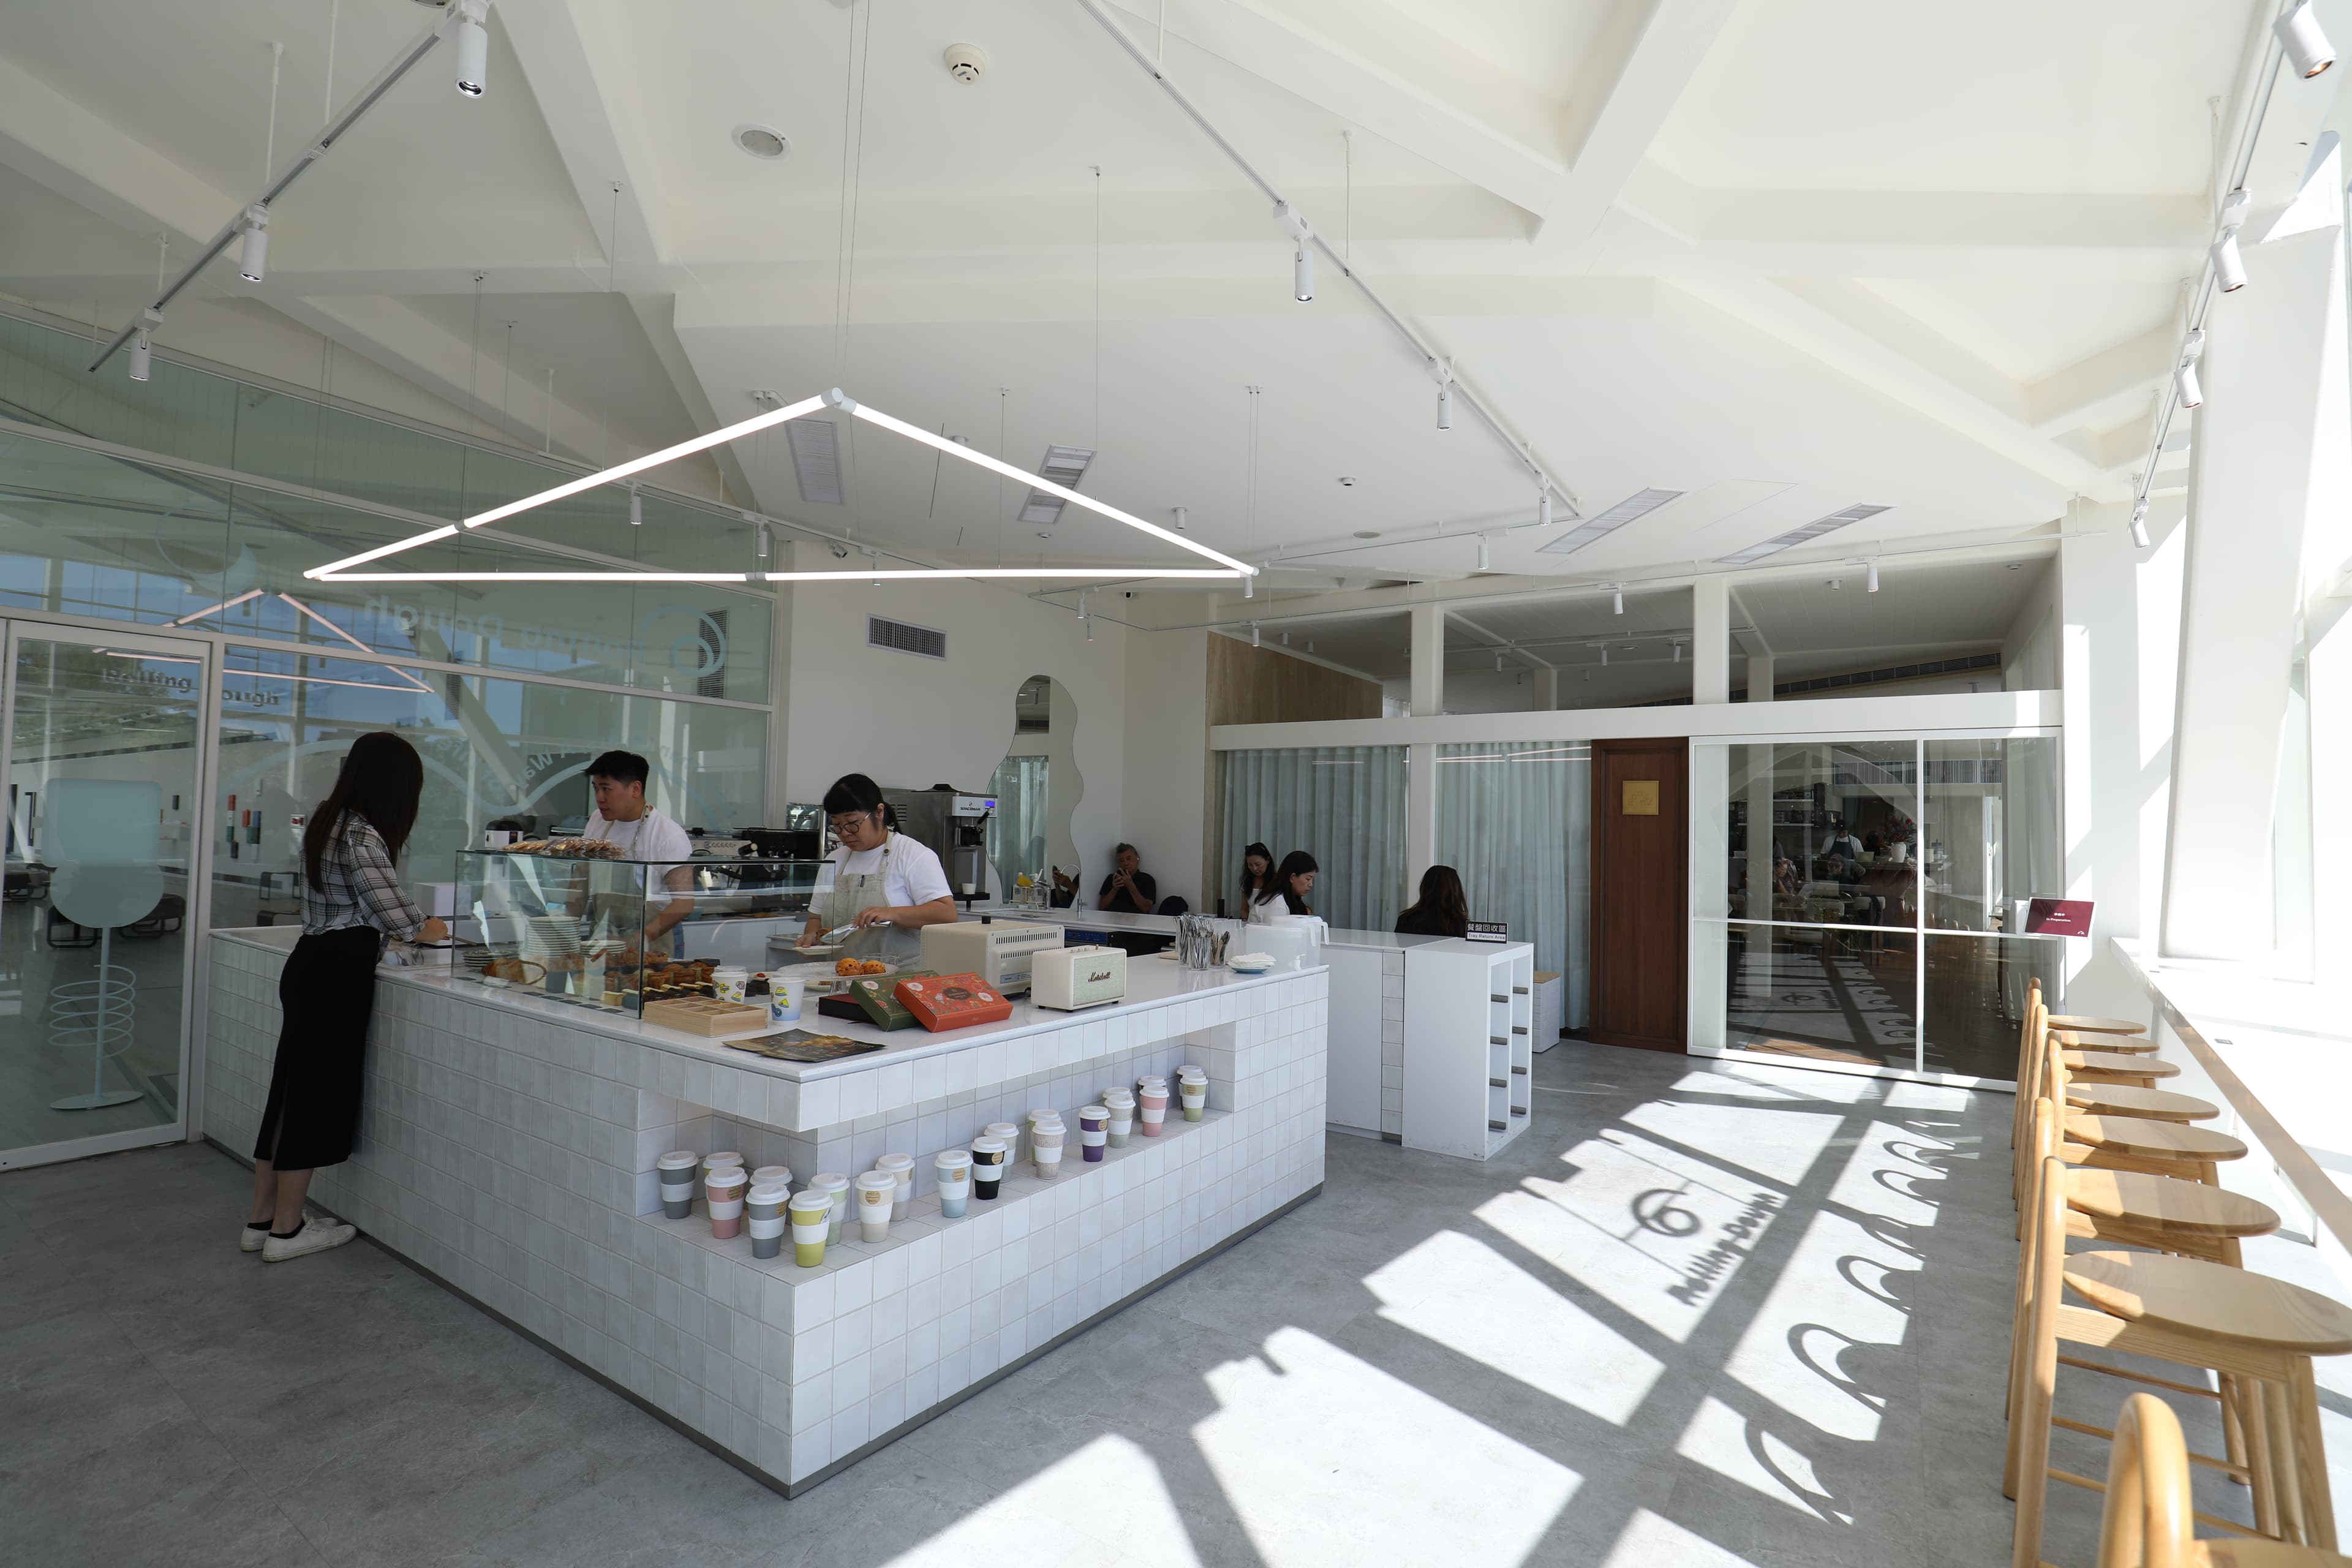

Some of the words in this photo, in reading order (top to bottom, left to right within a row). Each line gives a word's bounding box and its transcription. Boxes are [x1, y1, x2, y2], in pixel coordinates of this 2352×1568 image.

[221, 688, 279, 707] ough
[1468, 923, 1506, 932] 餐盤回收區
[1088, 971, 1111, 982] Marshall
